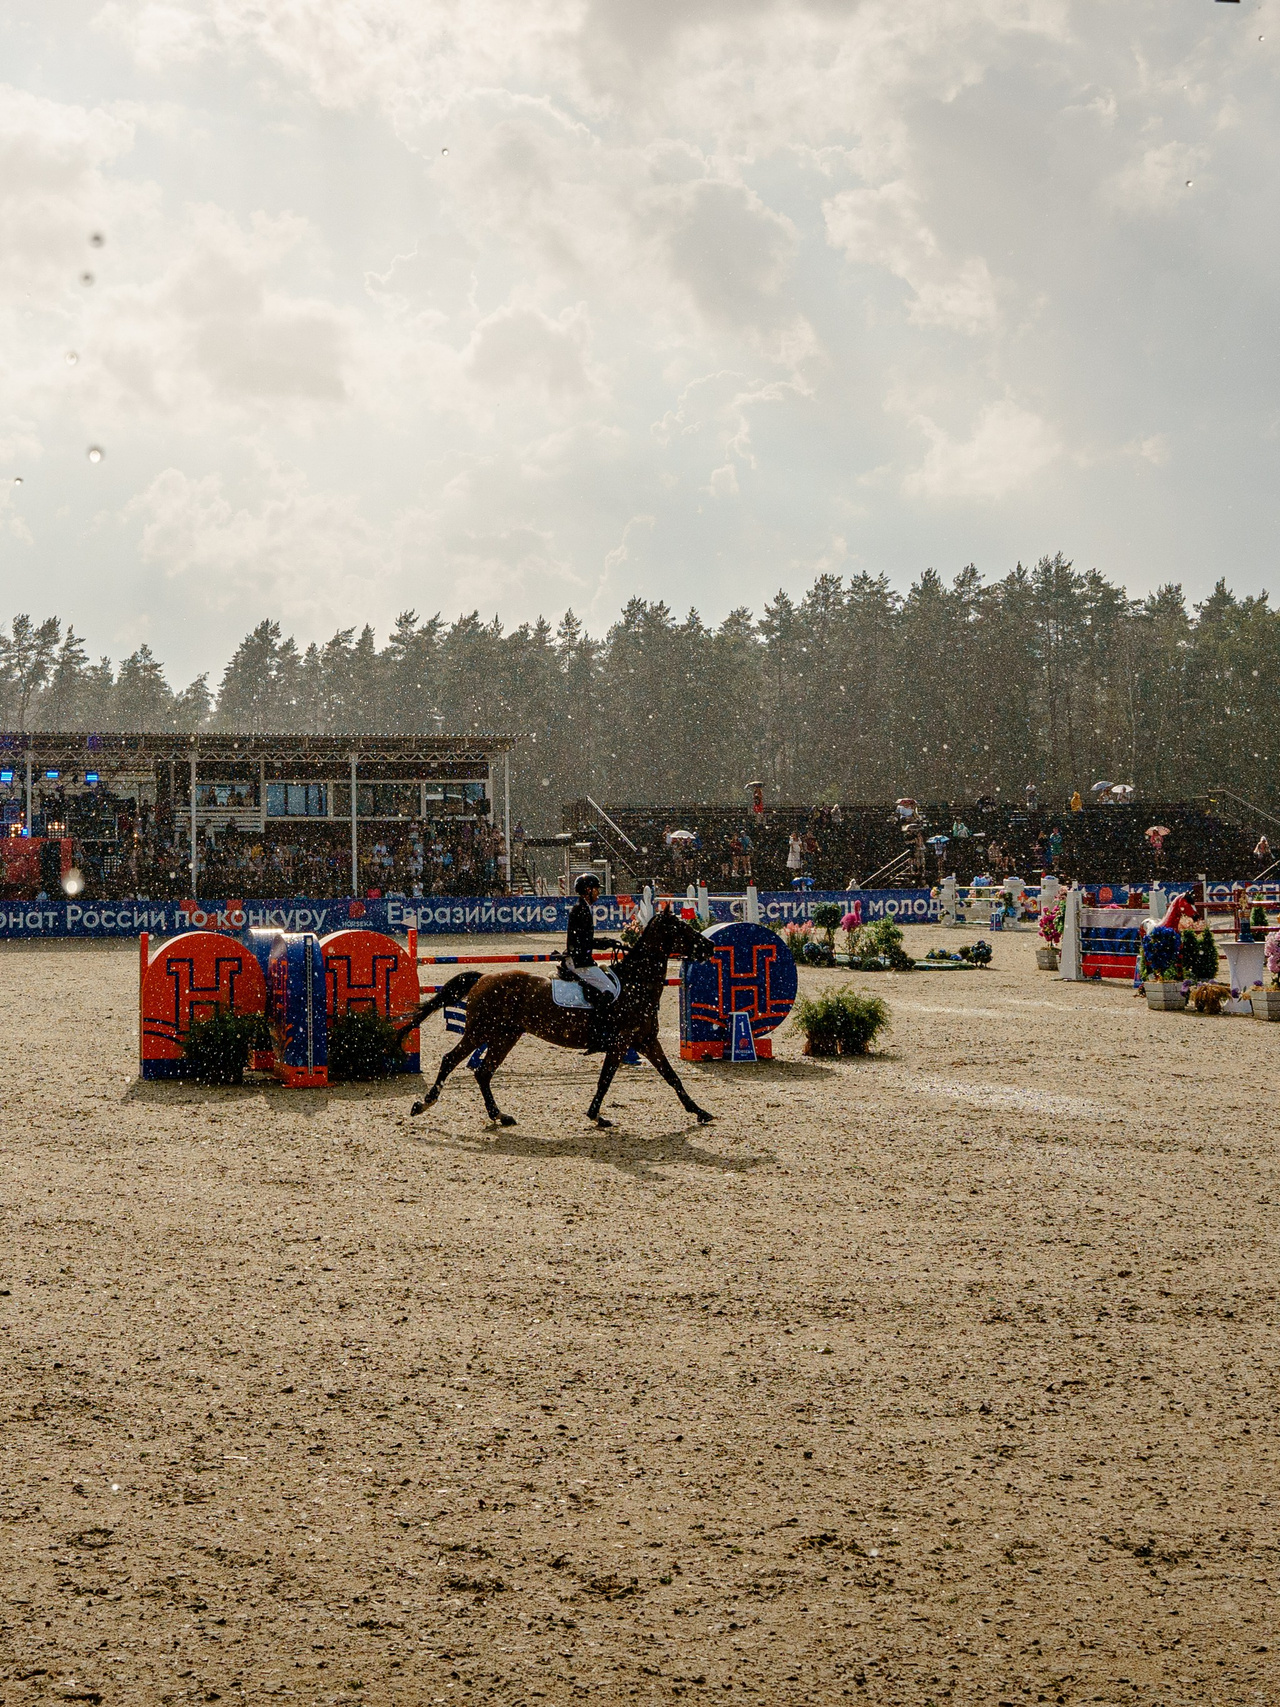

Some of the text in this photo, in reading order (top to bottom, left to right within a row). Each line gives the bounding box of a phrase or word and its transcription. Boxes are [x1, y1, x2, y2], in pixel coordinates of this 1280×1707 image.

[66, 905, 166, 930] России
[174, 910, 208, 928] по
[219, 908, 328, 931] конкуру
[387, 902, 557, 929] Евразийские
[869, 898, 942, 918] молод
[739, 1021, 745, 1032] 1
